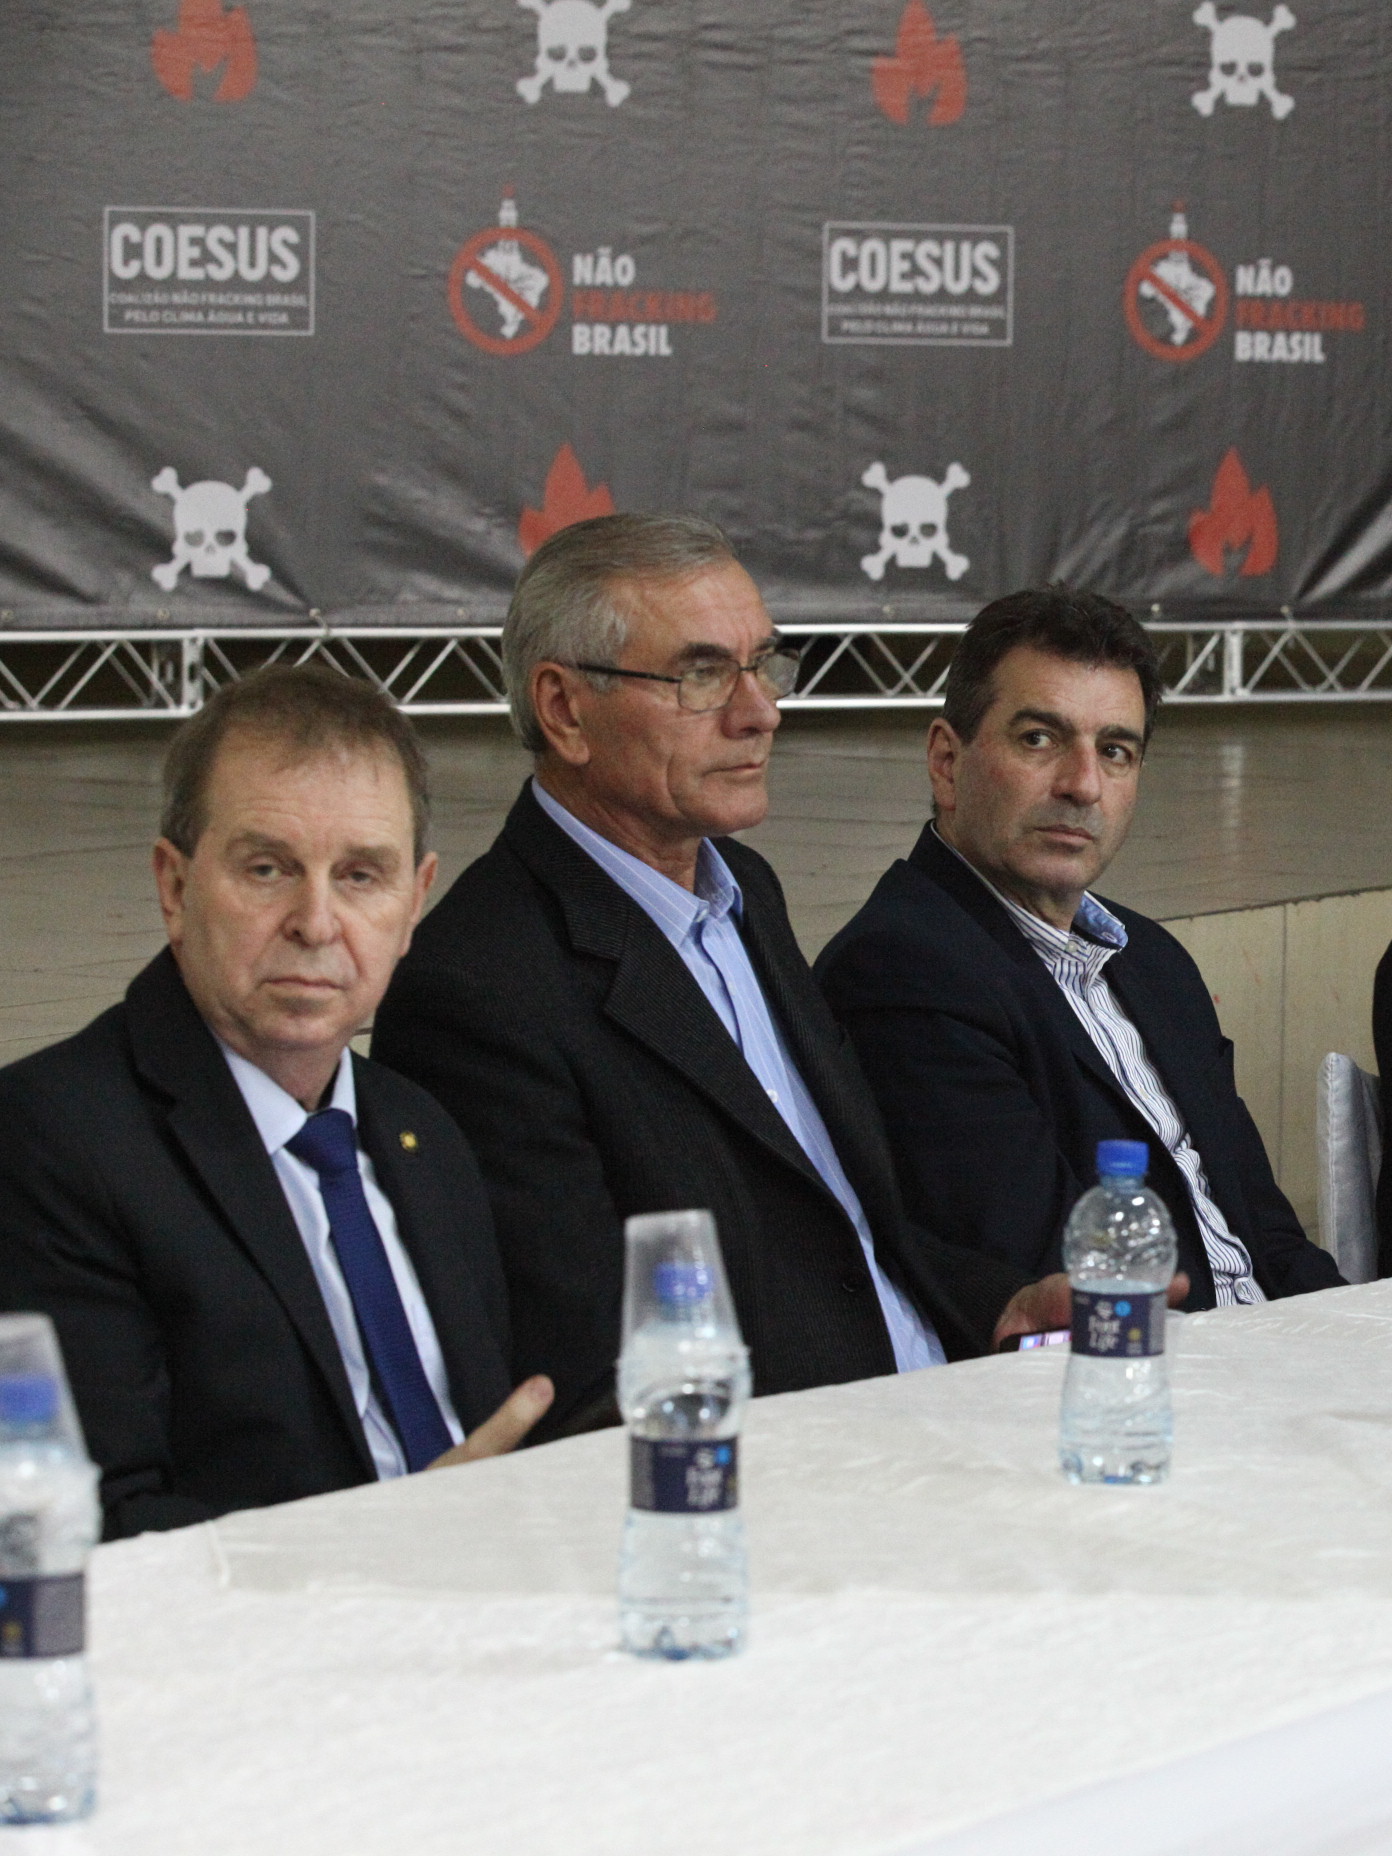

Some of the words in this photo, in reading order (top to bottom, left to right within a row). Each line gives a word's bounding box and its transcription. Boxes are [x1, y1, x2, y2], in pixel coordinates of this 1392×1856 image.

[110, 222, 301, 283] COESUS
[573, 247, 636, 287] NÃO
[830, 237, 1001, 296] COESUS
[1236, 258, 1293, 298] NÃO
[572, 323, 673, 356] BRASIL
[1235, 331, 1326, 363] BRASIL
